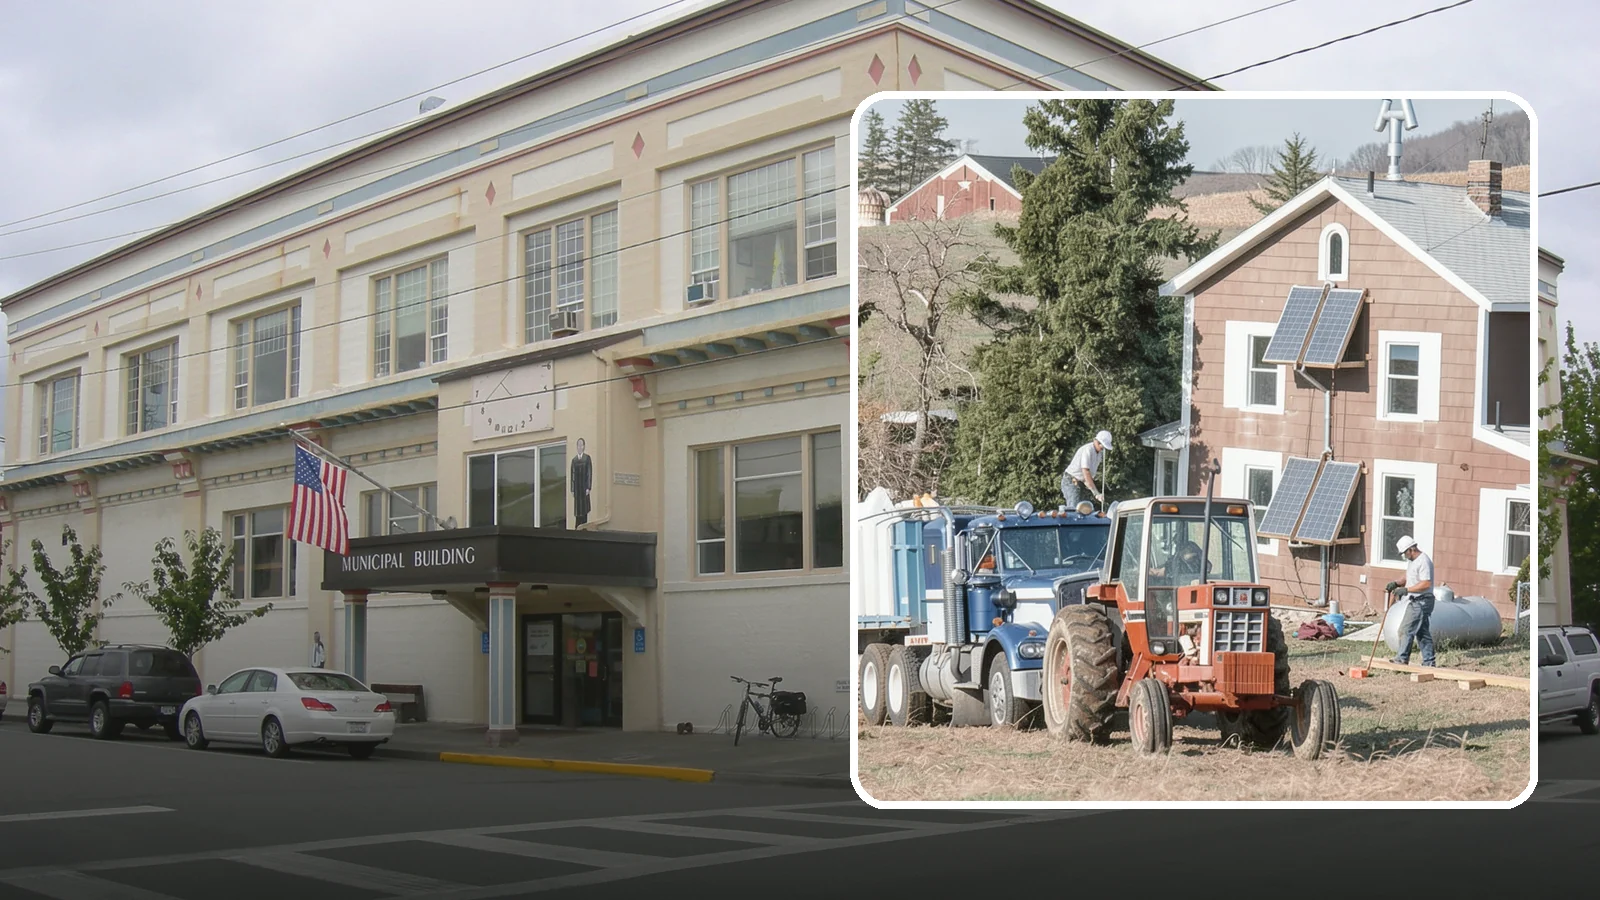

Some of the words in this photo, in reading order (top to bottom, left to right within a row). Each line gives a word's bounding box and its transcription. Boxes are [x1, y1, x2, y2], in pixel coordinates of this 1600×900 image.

[475, 390, 479, 398] 7
[536, 402, 540, 410] 4
[480, 407, 485, 415] 8
[529, 414, 533, 422] 3
[521, 420, 525, 428] 2
[507, 425, 513, 433] 12
[342, 552, 405, 572] MUNICIPAL
[414, 546, 475, 567] BUILDING
